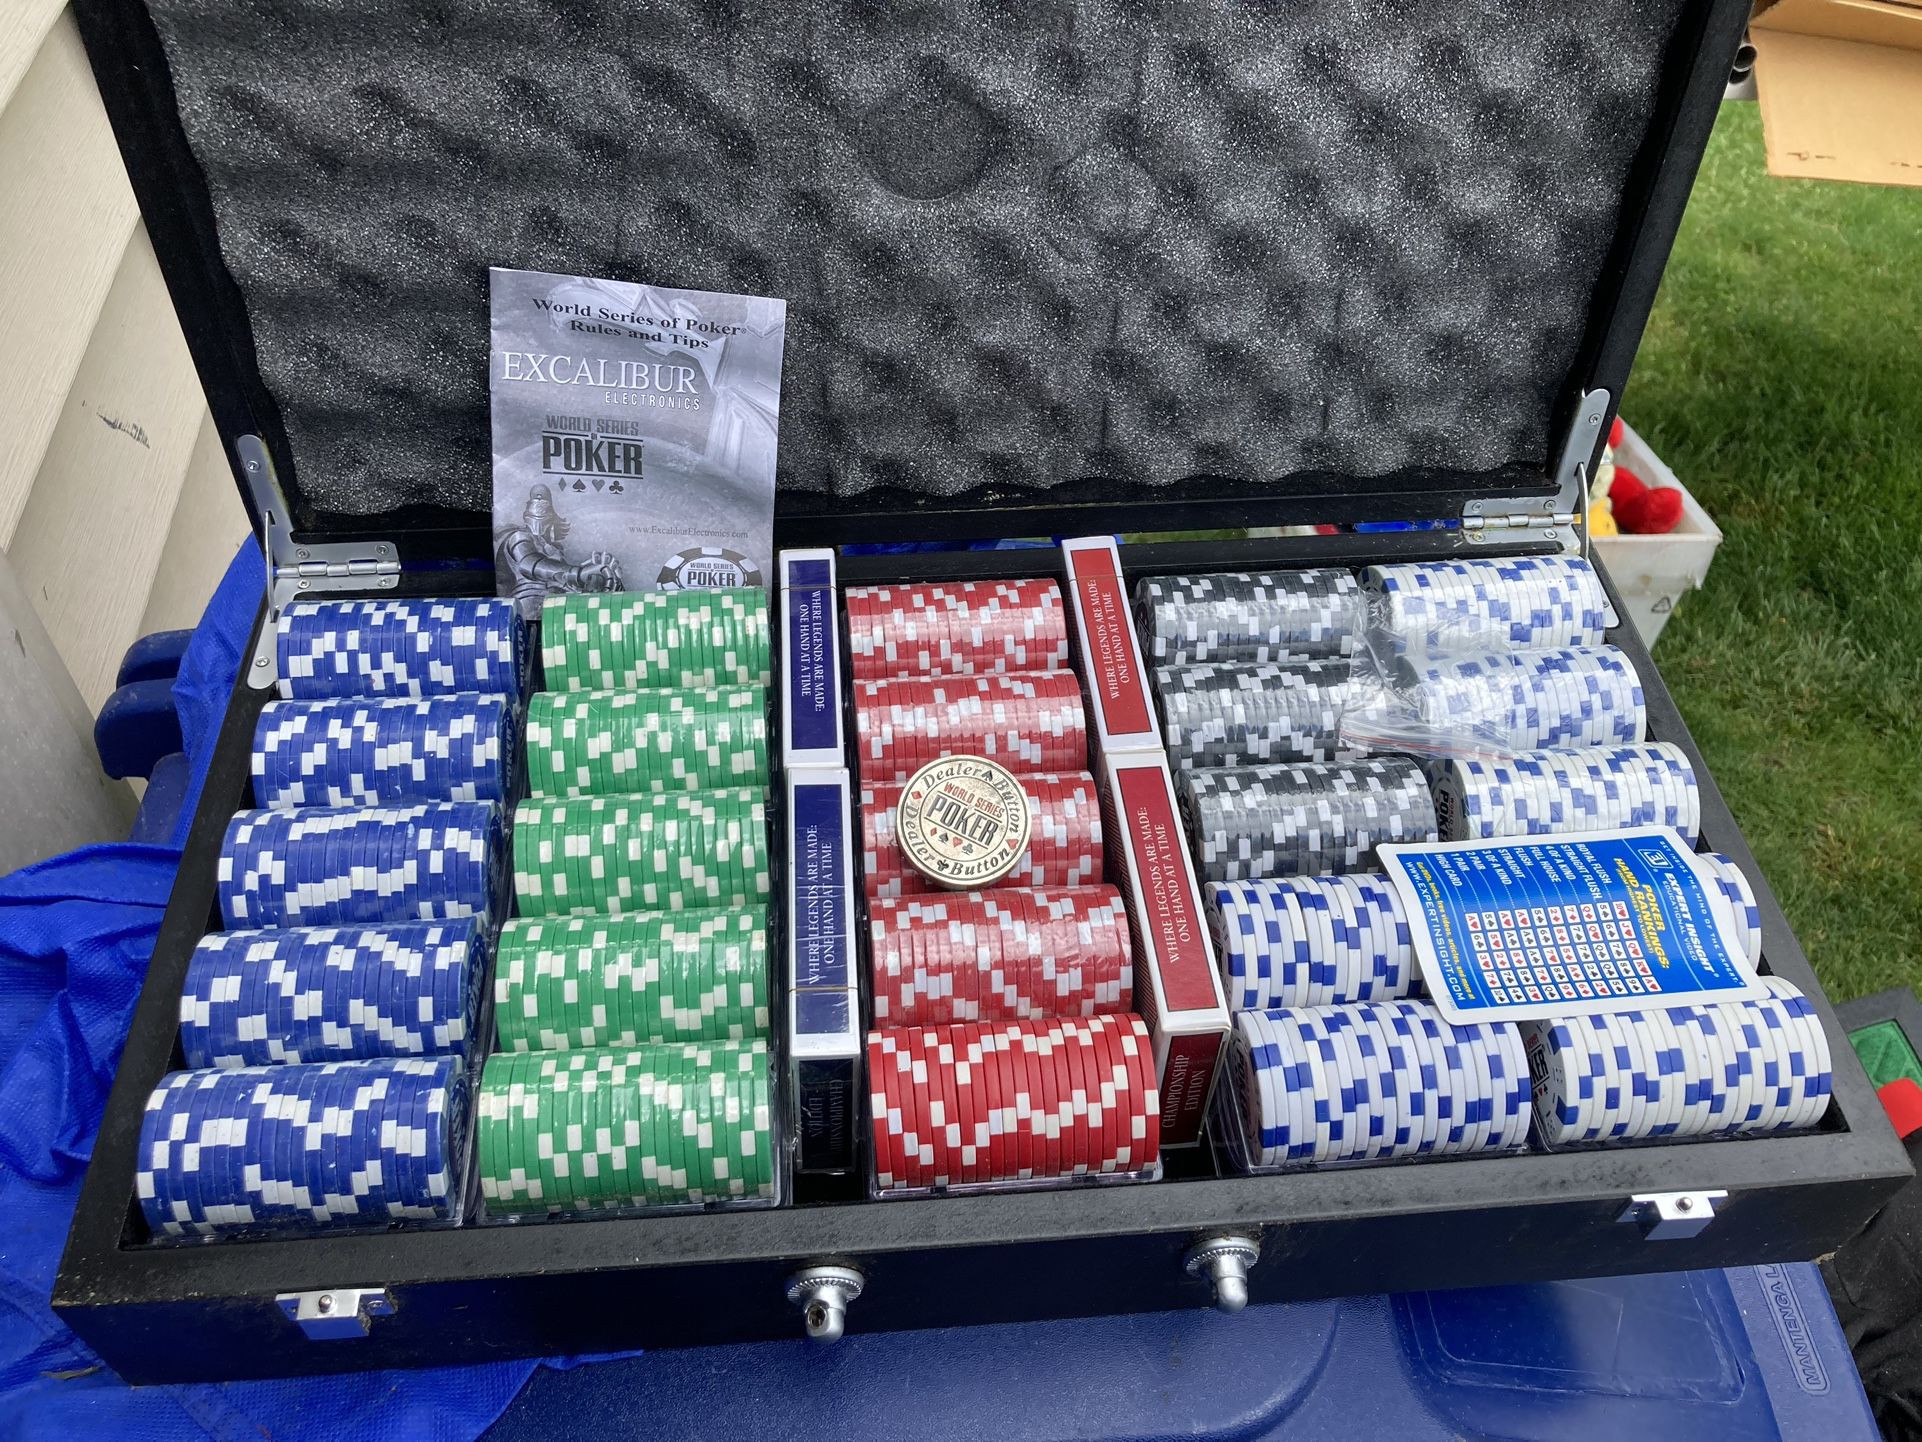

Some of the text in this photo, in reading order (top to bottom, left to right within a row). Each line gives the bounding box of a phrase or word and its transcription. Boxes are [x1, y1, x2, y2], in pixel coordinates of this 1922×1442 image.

[532, 298, 591, 317] World
[598, 308, 654, 327] Series
[660, 317, 681, 329] of
[570, 320, 709, 349] Rules and Tips
[502, 351, 698, 395] EXCALIBUR
[605, 391, 701, 411] ELECTRONICS
[545, 415, 640, 436] WORLD SERIES
[542, 435, 643, 476] POKER
[629, 525, 748, 539] www.ExcaliburElectronics.com
[687, 572, 735, 586] POKER
[800, 604, 809, 624] ONE
[812, 590, 822, 621] WHERE
[1094, 606, 1104, 622] ARE
[1103, 592, 1115, 613] TIME
[800, 624, 810, 651] HAND
[813, 622, 824, 662] LEGENDS
[1098, 624, 1113, 664] LEGENDS
[1109, 623, 1119, 635] AT
[801, 652, 810, 664] AT
[1113, 635, 1125, 663] HAND
[801, 674, 811, 696] TIME
[814, 664, 824, 680] ARE
[1106, 665, 1119, 699] WHERE
[1118, 663, 1130, 683] ONE
[922, 763, 983, 790] Dealer
[944, 782, 976, 803] WORLD
[974, 799, 1005, 818] SERIES
[992, 779, 1020, 833] Button
[1439, 789, 1449, 842] POKE
[905, 802, 935, 861] Dealer
[927, 794, 998, 846] POKER
[1155, 823, 1169, 852] TIME
[822, 842, 832, 871] TIME
[949, 847, 1010, 875] Button
[1146, 843, 1158, 864] ARE
[1452, 857, 1470, 871] PAIR
[1468, 855, 1486, 869] PAIR
[1484, 854, 1498, 862] OF
[1493, 868, 1513, 884] KIND
[1496, 848, 1525, 878] STRAIGHT
[1513, 847, 1534, 865] FLUSH
[1528, 846, 1546, 860] FULL
[1538, 860, 1561, 882] HOUSE
[1575, 843, 1597, 862] ROYAL
[1589, 863, 1612, 883] FLUSH
[807, 862, 818, 883] ARE
[1164, 864, 1177, 879] AT
[1434, 854, 1463, 886] HIGH CARD
[1557, 863, 1577, 879] KIND
[1559, 844, 1589, 874] STRAIGHT
[1581, 874, 1603, 898] FLUSH
[822, 884, 834, 899] AT
[1151, 865, 1170, 918] LEGENDS
[1168, 880, 1184, 914] HAND
[1625, 885, 1640, 912] HIGHEST
[1636, 914, 1643, 923] TO
[1669, 853, 1688, 872] INSIDE
[1686, 875, 1697, 889] THE
[1695, 893, 1707, 914] MIND
[1703, 918, 1712, 929] OF
[1709, 933, 1720, 949] THE
[808, 885, 819, 938] LEGENDS
[823, 900, 835, 936] HAND
[1613, 857, 1671, 969] HAND RANKINGS:
[1641, 884, 1666, 931] POKER
[1661, 880, 1698, 960] EDUCATIONAL VIDEO
[1663, 872, 1715, 972] EXPERT INSIGHT
[1162, 919, 1180, 963] WHERE
[1177, 916, 1191, 942] ONE
[823, 937, 835, 964] ONE
[1436, 900, 1445, 912] free
[1460, 978, 1471, 993] more
[809, 941, 820, 984] WHERE
[1161, 1054, 1190, 1128] CHAMPIONSHIP
[1184, 1069, 1206, 1112] EDITION
[808, 1097, 824, 1138] EDITION
[830, 1079, 844, 1152] CHAMPIONSHIP
[1771, 1282, 1821, 1385] MANTENGA
